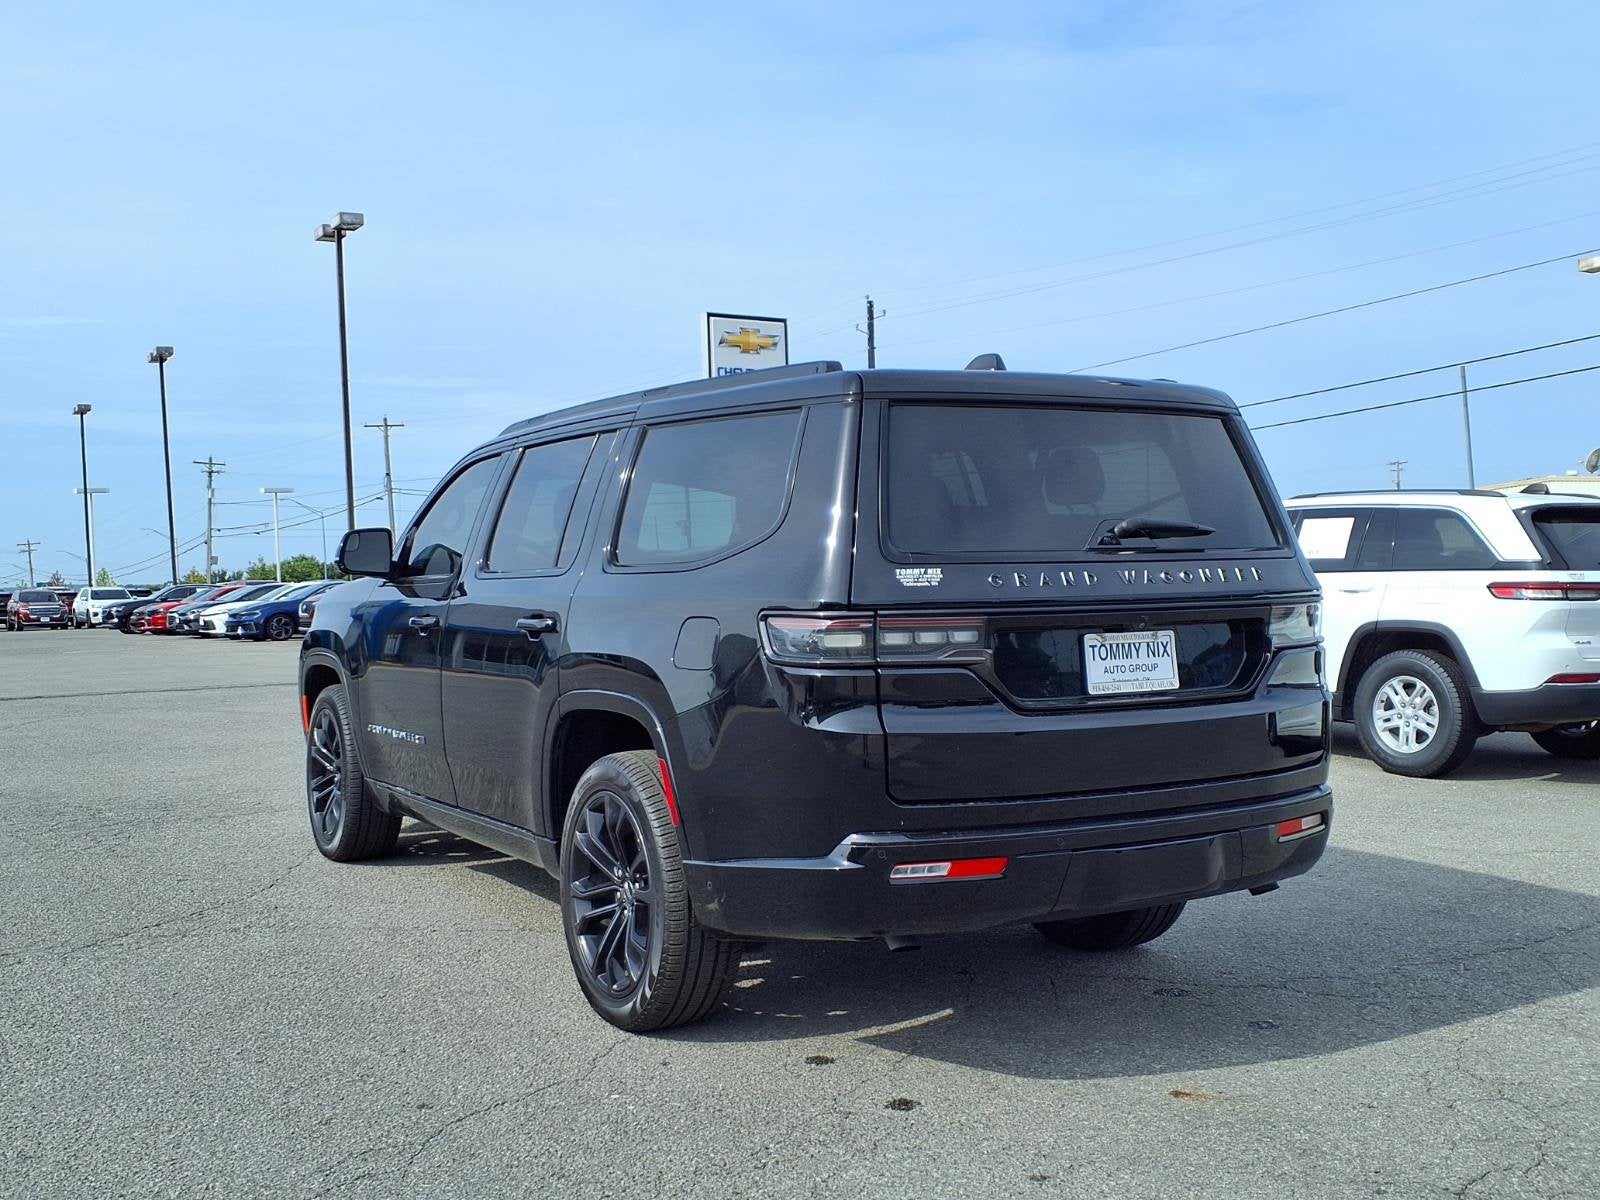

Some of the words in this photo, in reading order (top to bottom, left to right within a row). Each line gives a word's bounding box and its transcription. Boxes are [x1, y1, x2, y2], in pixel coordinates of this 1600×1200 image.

[988, 571, 1098, 588] GRAND
[1115, 566, 1265, 586] WAGONEER
[1089, 642, 1141, 661] TOMMY
[1146, 641, 1170, 658] NIX
[1103, 664, 1127, 675] AUTO
[1128, 663, 1159, 673] GROUP
